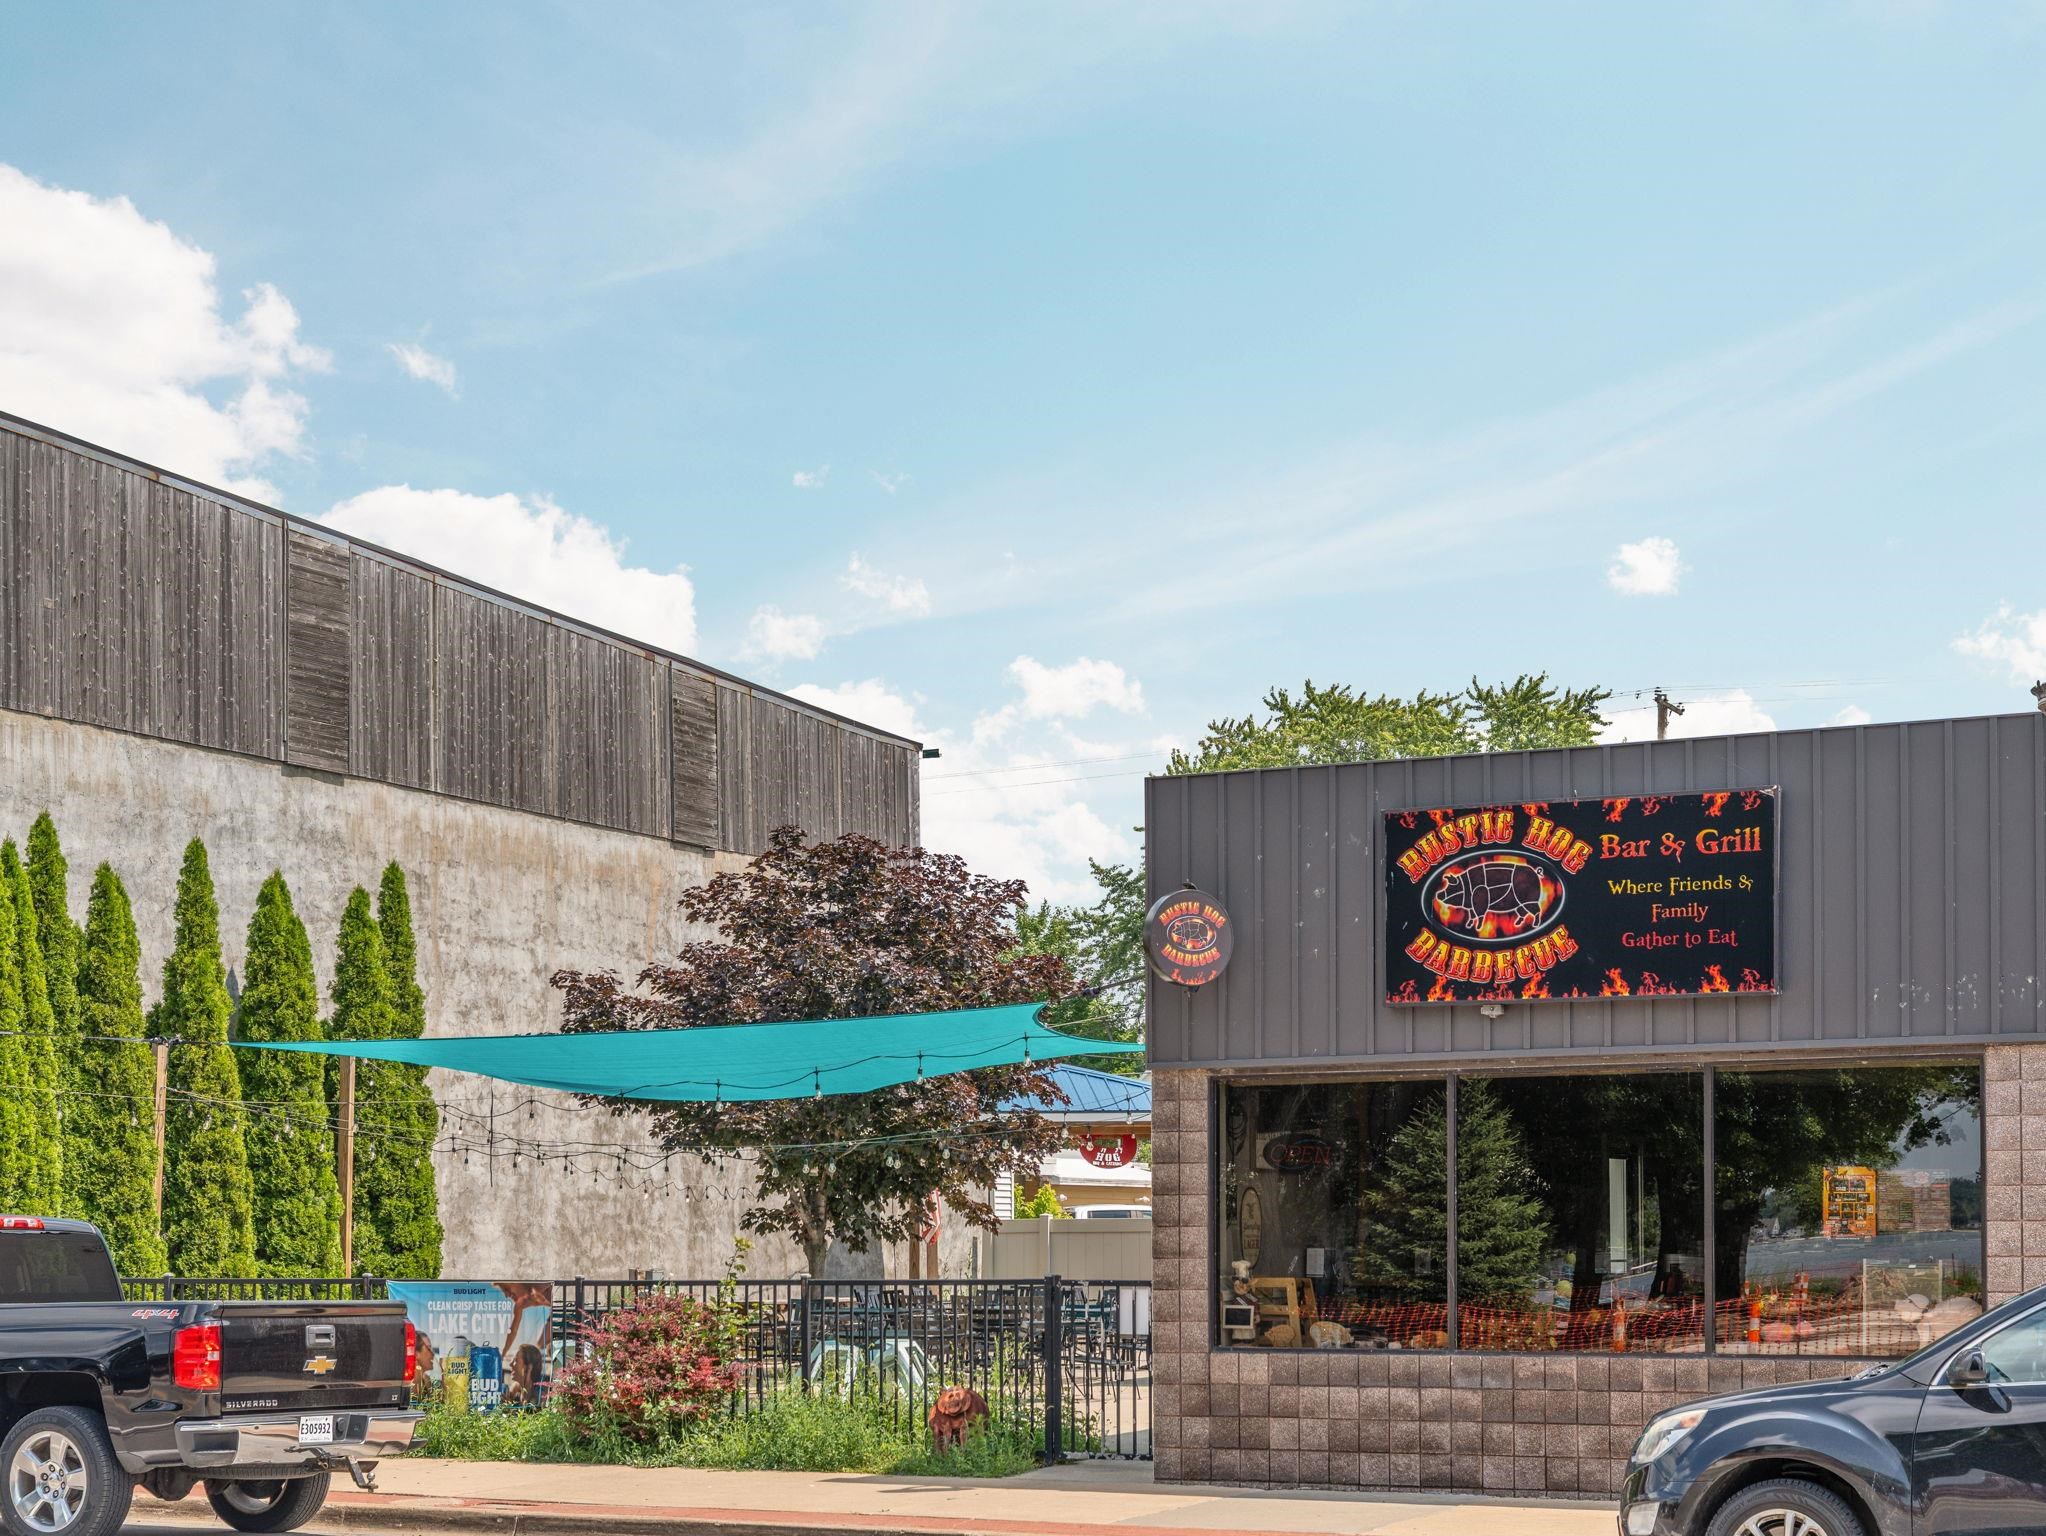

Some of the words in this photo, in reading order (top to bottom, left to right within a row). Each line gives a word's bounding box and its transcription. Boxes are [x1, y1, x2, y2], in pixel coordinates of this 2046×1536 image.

[1396, 811, 1514, 884] RUSTIC
[1522, 815, 1594, 875] HOG
[1599, 834, 1651, 859] Bar
[1660, 832, 1686, 863] &
[1696, 826, 1762, 854] Grill
[1607, 879, 1663, 895] Where
[1669, 875, 1733, 896] Friends
[1738, 874, 1754, 892] &
[1650, 902, 1709, 923] Family
[1621, 931, 1680, 950] Gather
[1685, 931, 1702, 948] to
[1708, 928, 1739, 947] Eat
[1404, 925, 1580, 984] BARBECUE
[1095, 1152, 1121, 1162] HOG
[427, 1301, 452, 1311] CLEAN
[452, 1301, 473, 1311] CRISP
[474, 1301, 496, 1311] TASTE
[497, 1301, 512, 1311] FOR
[428, 1313, 468, 1334] LAKE
[471, 1313, 513, 1334] CITY!
[471, 1378, 499, 1391] BUD
[225, 1399, 279, 1408] SILVERADO
[300, 1422, 331, 1435] E305932
